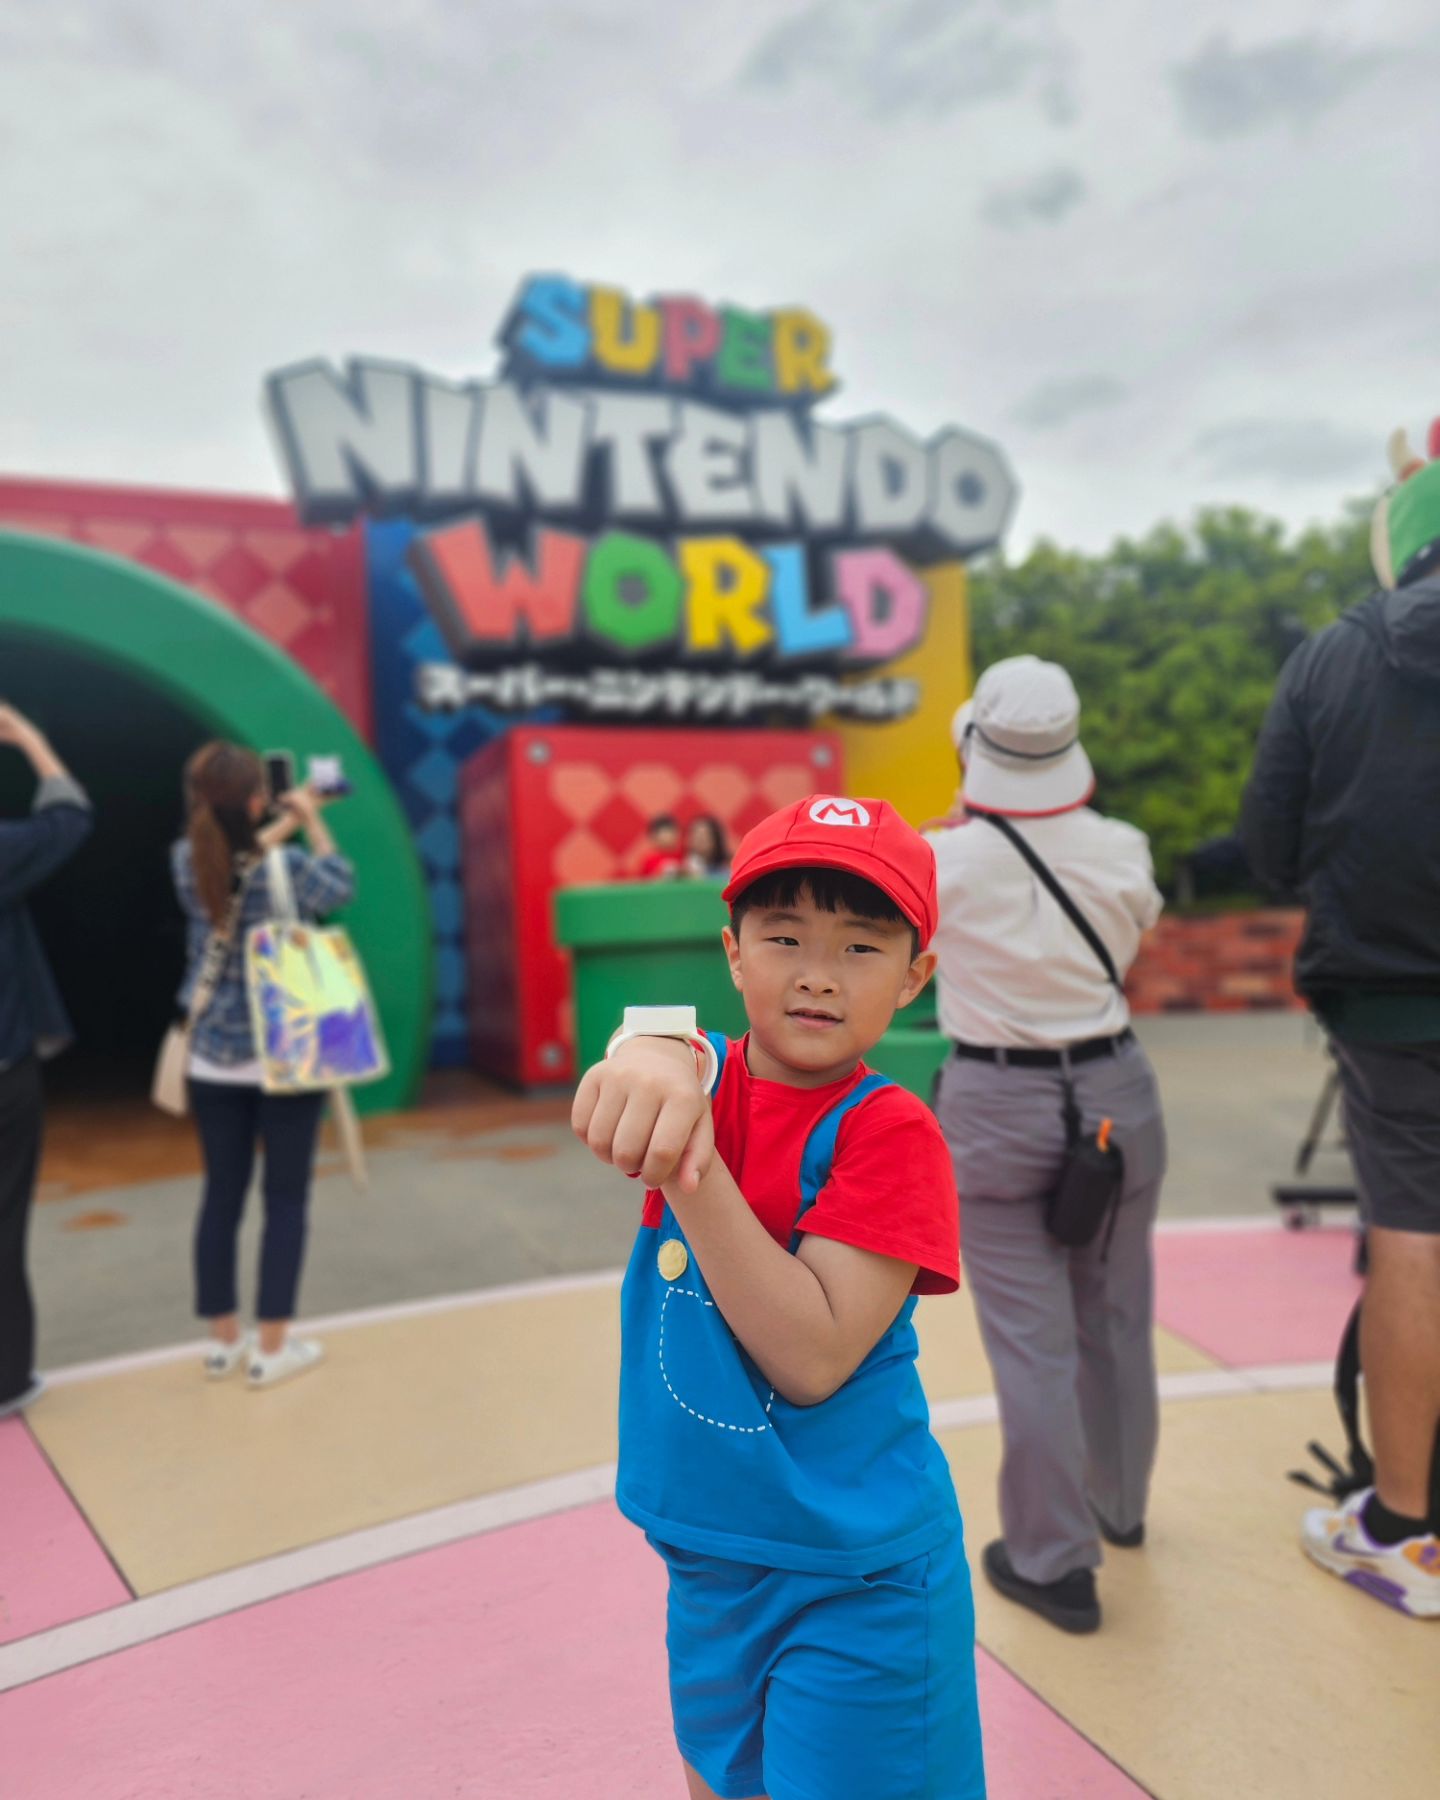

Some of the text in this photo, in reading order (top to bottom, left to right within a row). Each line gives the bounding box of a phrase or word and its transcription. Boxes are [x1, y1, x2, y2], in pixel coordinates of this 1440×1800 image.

[514, 273, 836, 392] SUPER
[270, 360, 1014, 543] NINTENDO
[426, 520, 925, 657] WORLD
[815, 802, 862, 825] M
